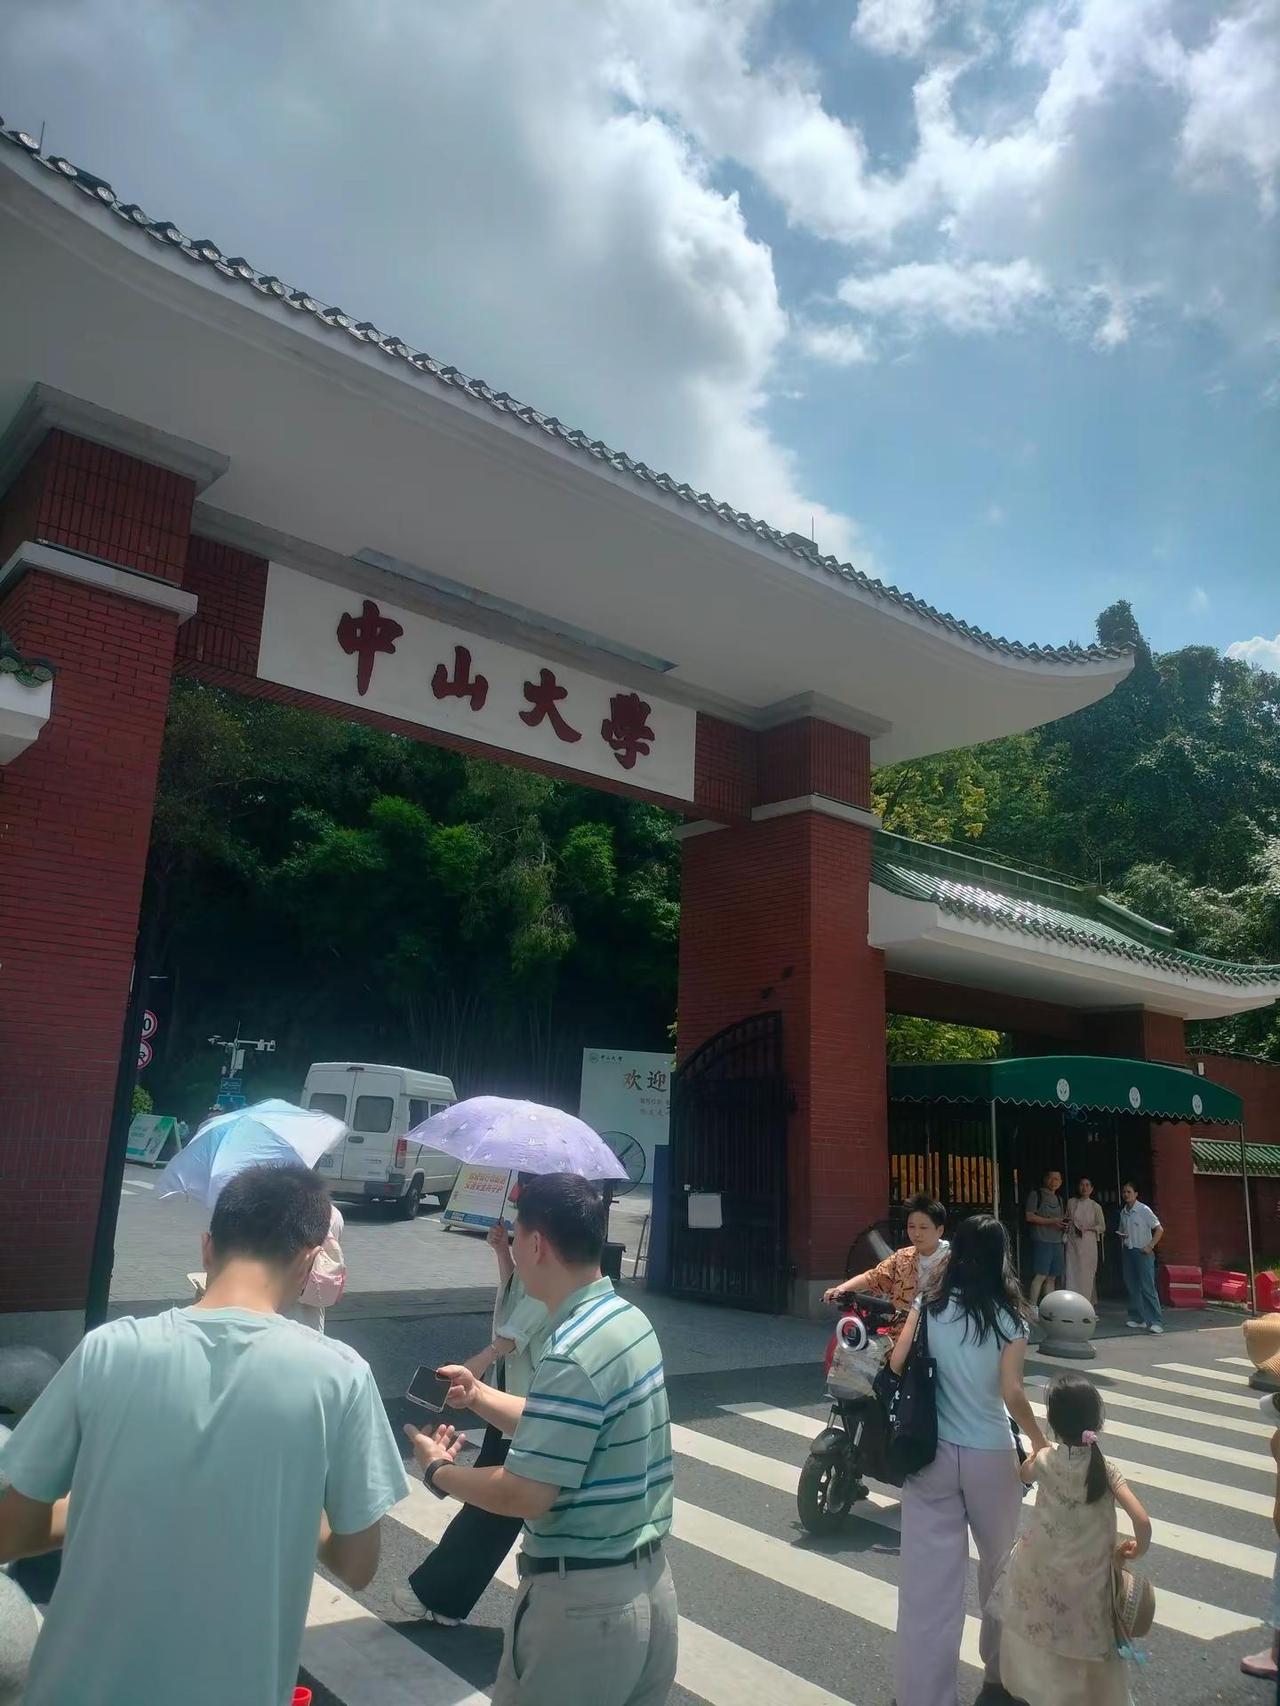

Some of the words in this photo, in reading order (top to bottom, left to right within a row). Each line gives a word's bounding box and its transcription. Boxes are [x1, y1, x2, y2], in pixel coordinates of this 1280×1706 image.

[336, 599, 656, 770] 中山大學
[624, 1069, 667, 1092] 欢迎
